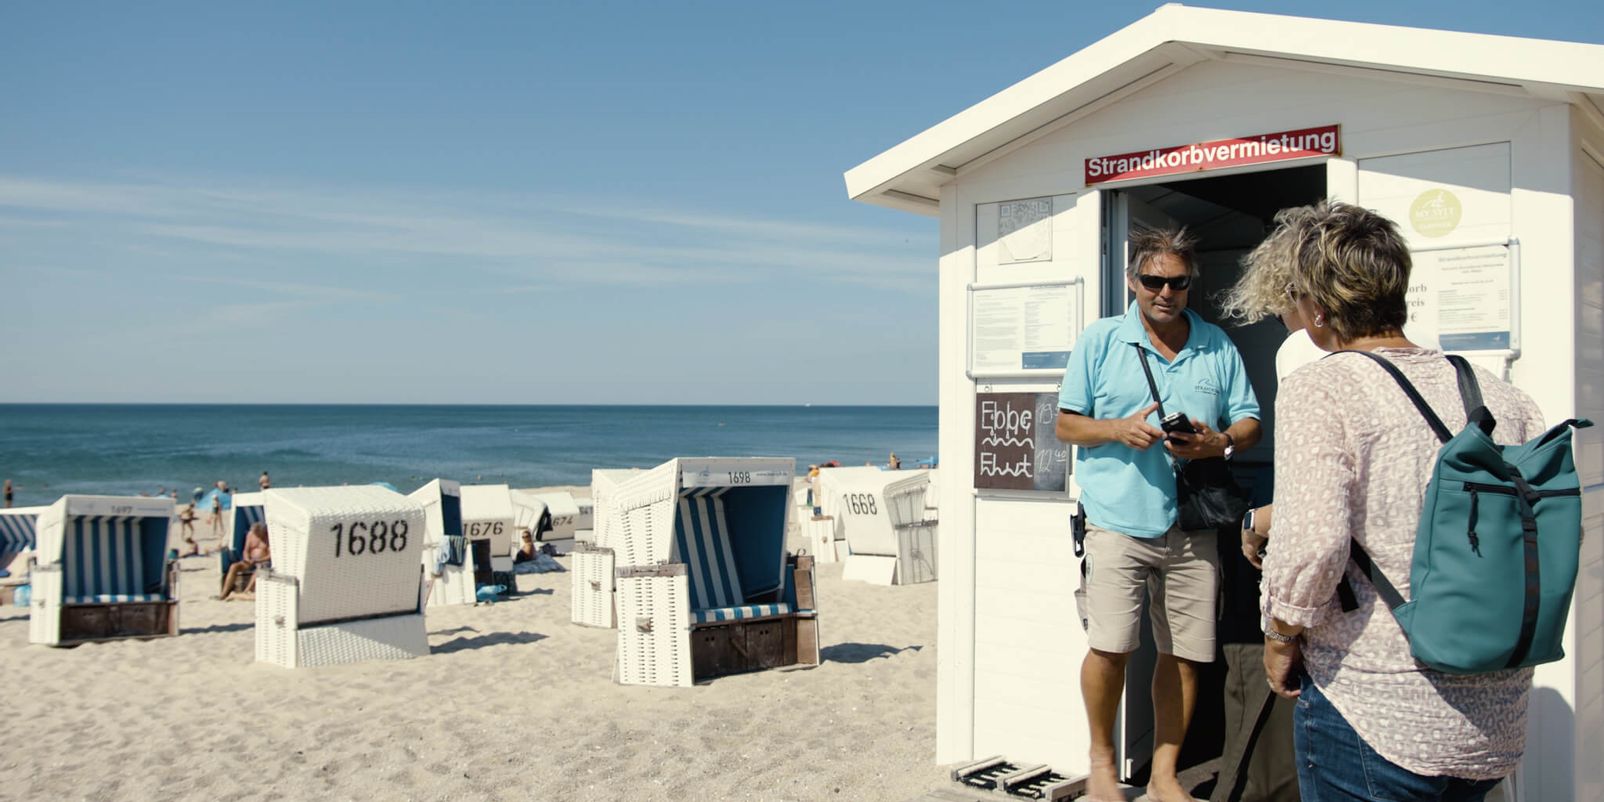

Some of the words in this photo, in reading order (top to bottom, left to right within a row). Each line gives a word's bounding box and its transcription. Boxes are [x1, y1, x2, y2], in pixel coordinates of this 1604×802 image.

[1087, 129, 1337, 178] Strandkorbvermietung
[981, 400, 1033, 434] Ebbe
[728, 471, 751, 484] 1698
[843, 493, 878, 516] 1668
[330, 519, 409, 558] 1688
[463, 521, 504, 537] 1676
